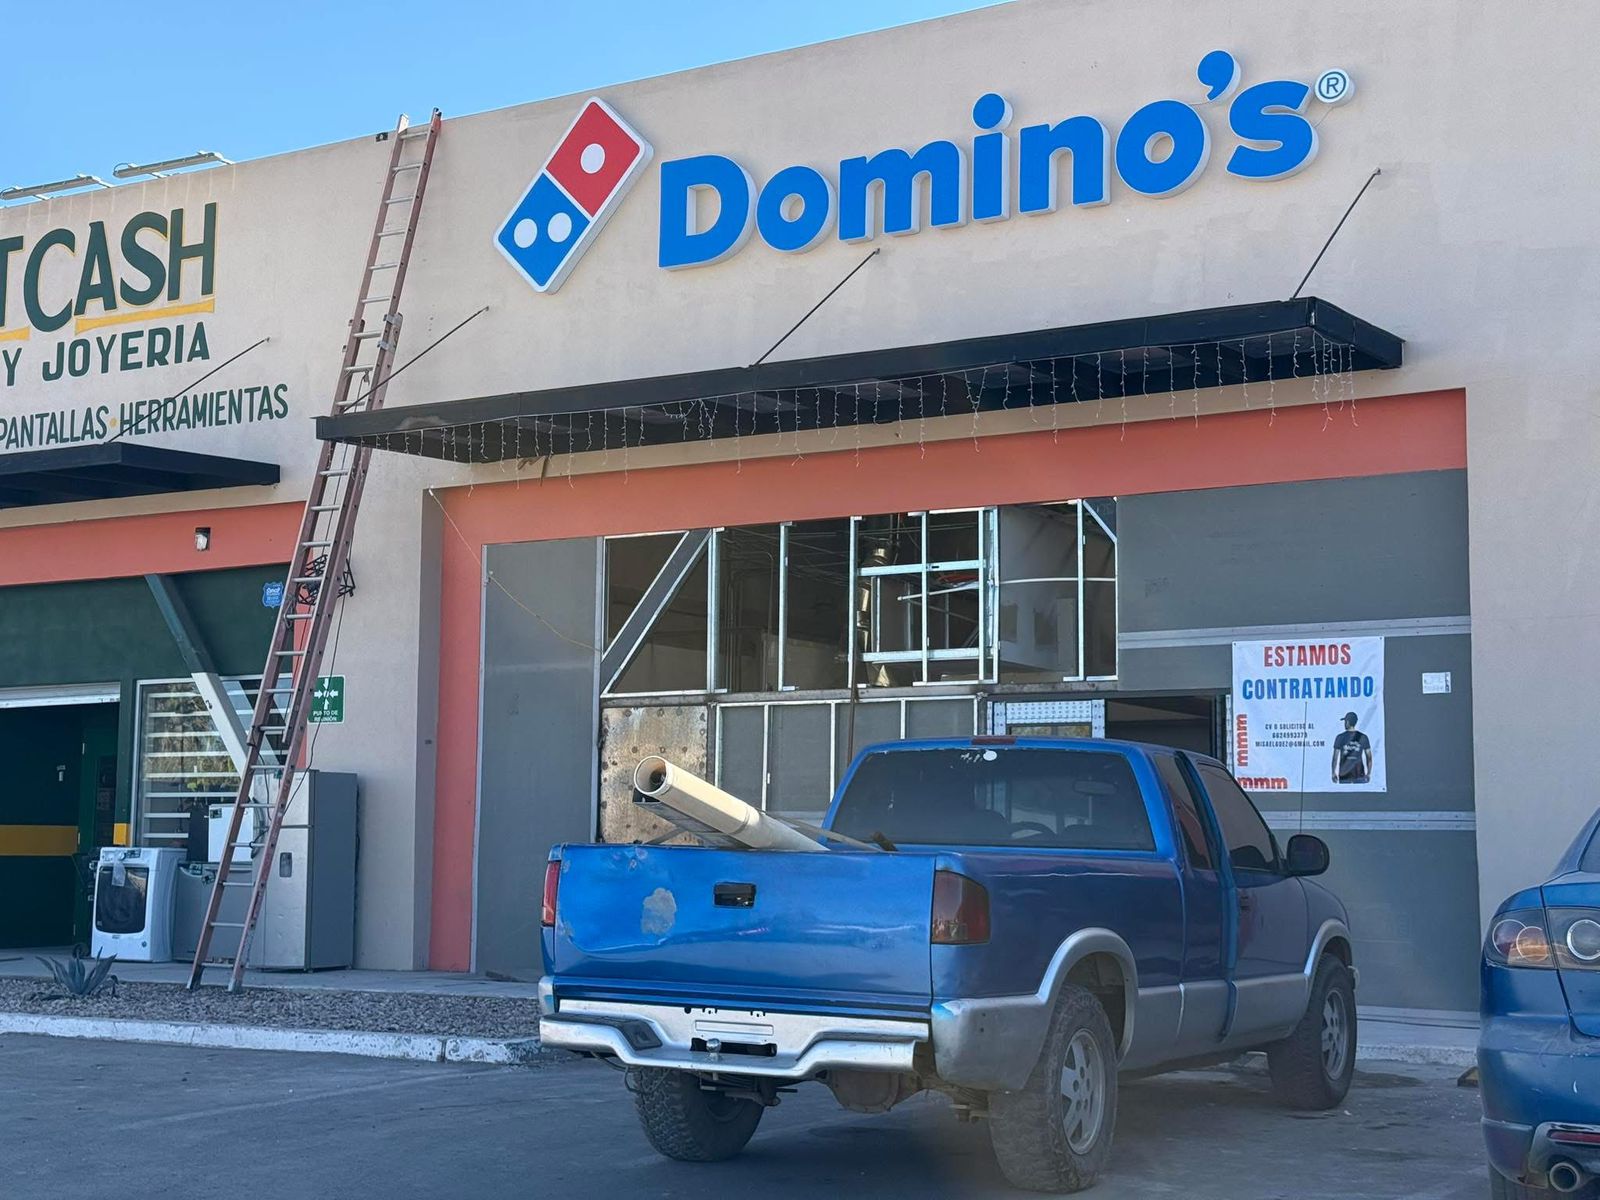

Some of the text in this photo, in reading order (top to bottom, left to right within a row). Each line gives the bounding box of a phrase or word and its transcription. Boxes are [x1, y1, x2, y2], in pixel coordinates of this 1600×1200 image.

[2, 322, 210, 386] Y JOYERIA
[120, 384, 288, 436] HERRAMIENTAS
[1264, 644, 1351, 667] ESTAMOS
[1242, 676, 1374, 700] CONTRATANDO
